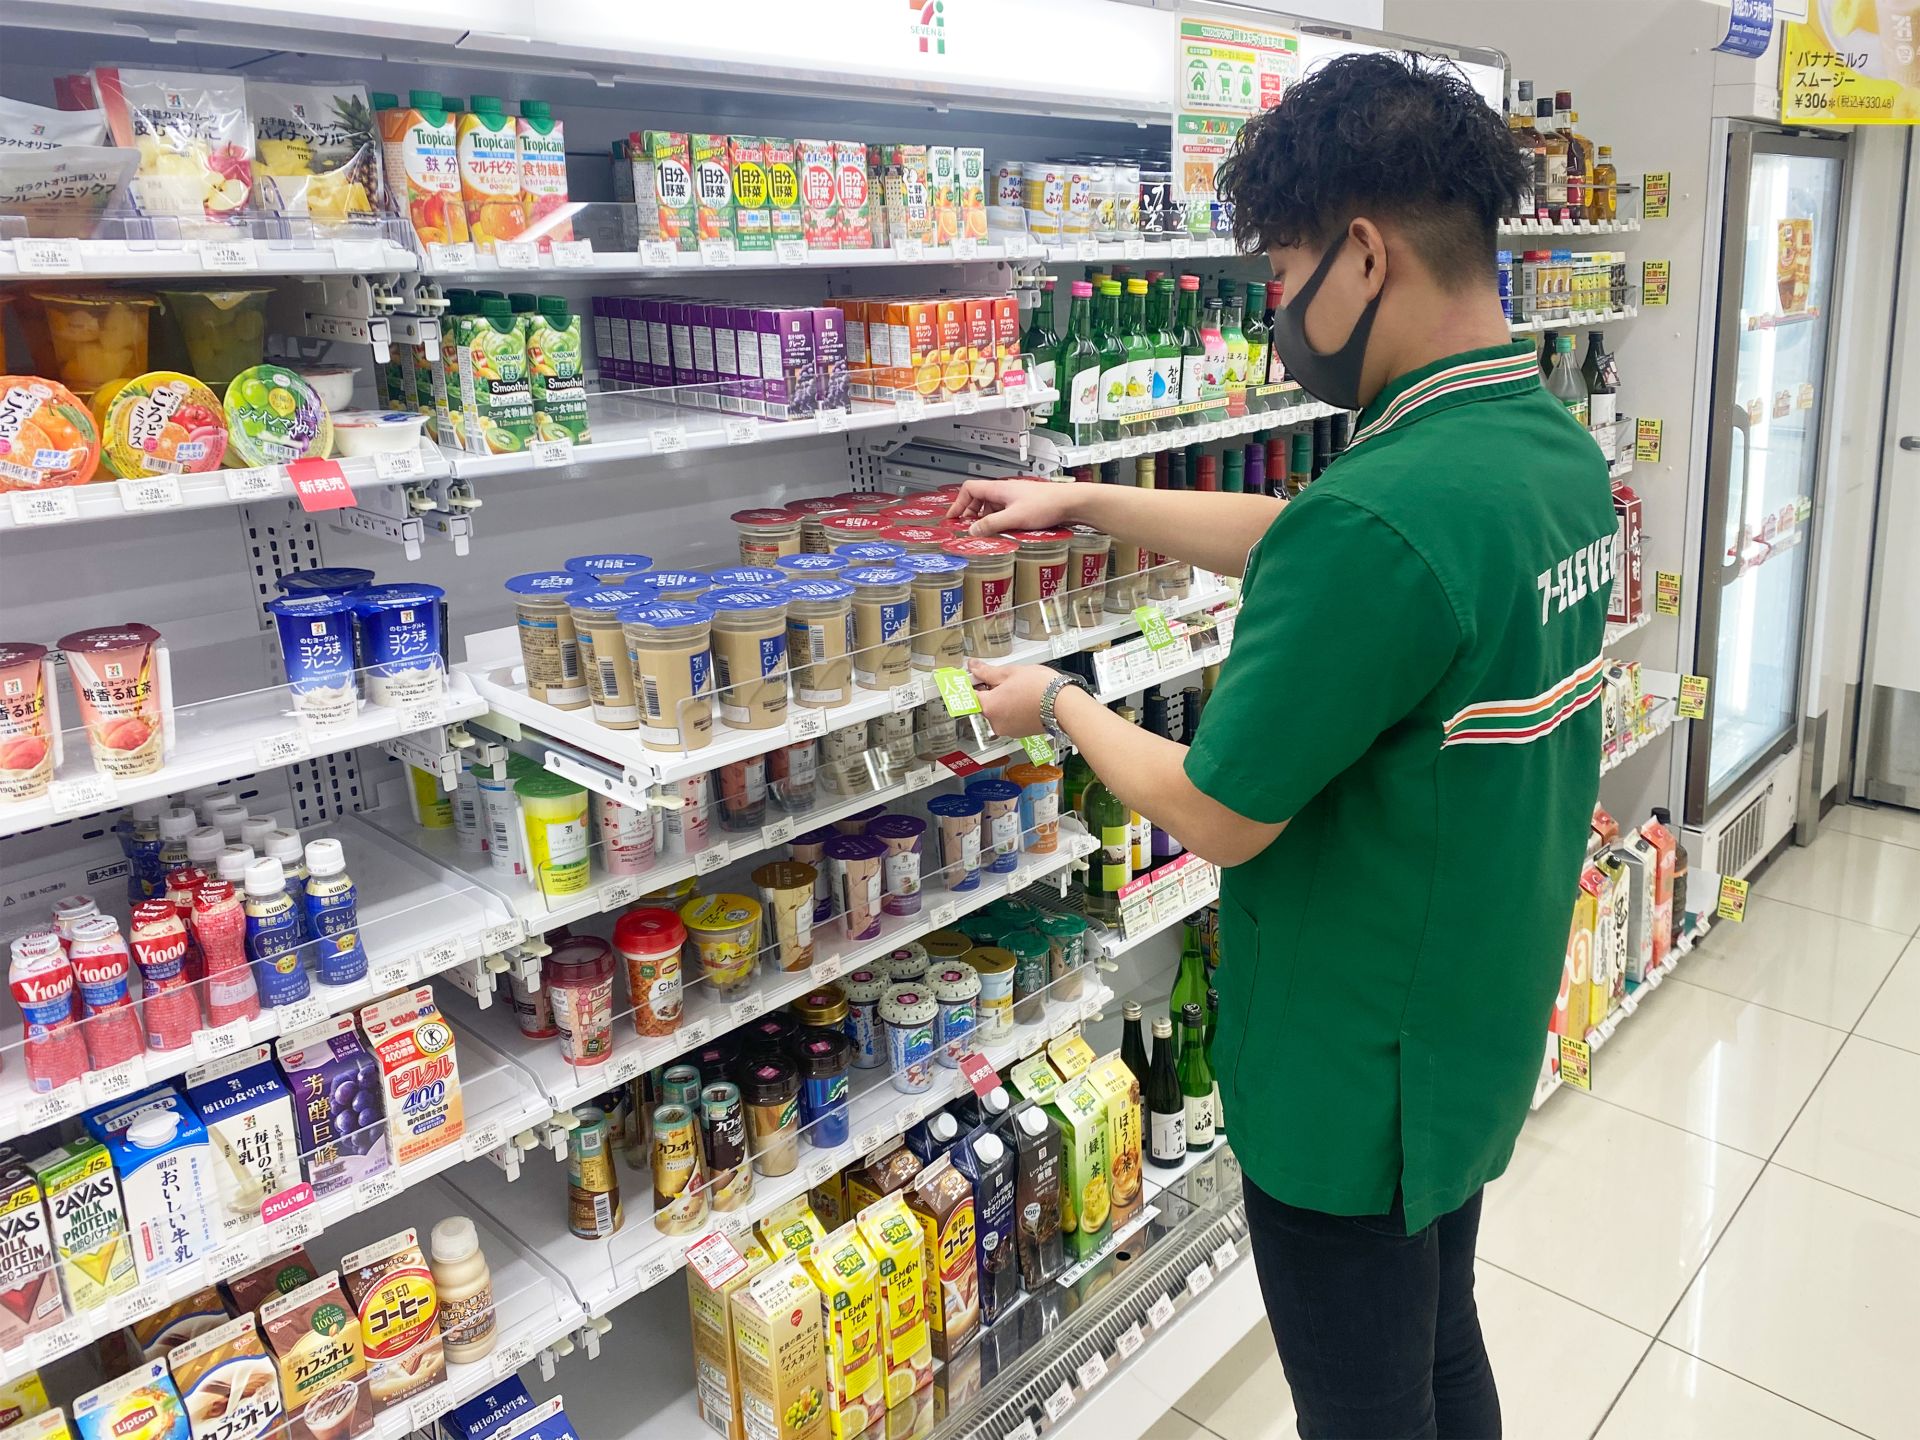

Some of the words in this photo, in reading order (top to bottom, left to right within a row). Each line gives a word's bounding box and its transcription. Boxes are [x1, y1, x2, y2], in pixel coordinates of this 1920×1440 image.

[1797, 52, 1868, 69] バナナミルク
[1796, 72, 1855, 88] スムージー
[257, 127, 346, 149] パイナップル
[667, 184, 686, 198] 野菜
[706, 185, 725, 198] 野菜
[742, 185, 761, 198] 野菜
[775, 185, 794, 198] 野菜
[811, 186, 829, 200] 野菜
[844, 186, 862, 200] 野菜
[492, 383, 529, 393] Smoothie
[548, 379, 583, 389] Smoothie
[131, 405, 143, 446] ミックス
[239, 406, 319, 439] シャインマスカット
[299, 477, 346, 494] 新発売
[1659, 573, 1675, 581] これは
[390, 622, 426, 632] のむヨーグルト
[300, 635, 339, 644] のむヨーグルト
[389, 629, 428, 645] コクうま
[300, 643, 342, 656] コクうま
[390, 643, 429, 656] プレーン
[302, 655, 343, 669] プレーン
[93, 677, 138, 687] のむヨーグルト
[944, 676, 971, 695] 人気
[82, 681, 152, 702] 桃香る紅茶
[949, 692, 976, 711] 商品
[949, 756, 975, 771] 新発売
[329, 884, 348, 894] KIRIN
[1724, 878, 1742, 887] これは
[266, 903, 287, 914] KIRIN
[136, 941, 187, 965] Y1000
[72, 962, 123, 984] Y1000
[21, 974, 73, 1003] Y1000
[1561, 1039, 1582, 1050] これは
[103, 1075, 123, 1086] ¥150
[390, 1055, 454, 1100] ピルクル
[969, 1066, 994, 1085] 新発売
[203, 1080, 279, 1114] 毎日の食卓牛乳
[401, 1079, 445, 1116] 400
[302, 1073, 338, 1167] 芳醇巨峰
[237, 1137, 255, 1166] 牛乳
[1088, 1136, 1101, 1180] 緑茶
[157, 1157, 178, 1170] 明治
[55, 1177, 114, 1219] SAVAS
[69, 1199, 104, 1226] MILK
[161, 1169, 193, 1264] おいしい牛乳
[63, 1208, 118, 1246] PROTEIN
[943, 1223, 975, 1260] コーヒー
[897, 1277, 913, 1291] TEA
[382, 1283, 410, 1306] 雪印
[369, 1295, 430, 1334] コーヒー
[851, 1311, 868, 1326] TEA
[295, 1341, 355, 1382] カフェオーレ
[783, 1344, 818, 1372] マスカット
[116, 1408, 155, 1434] Lipton
